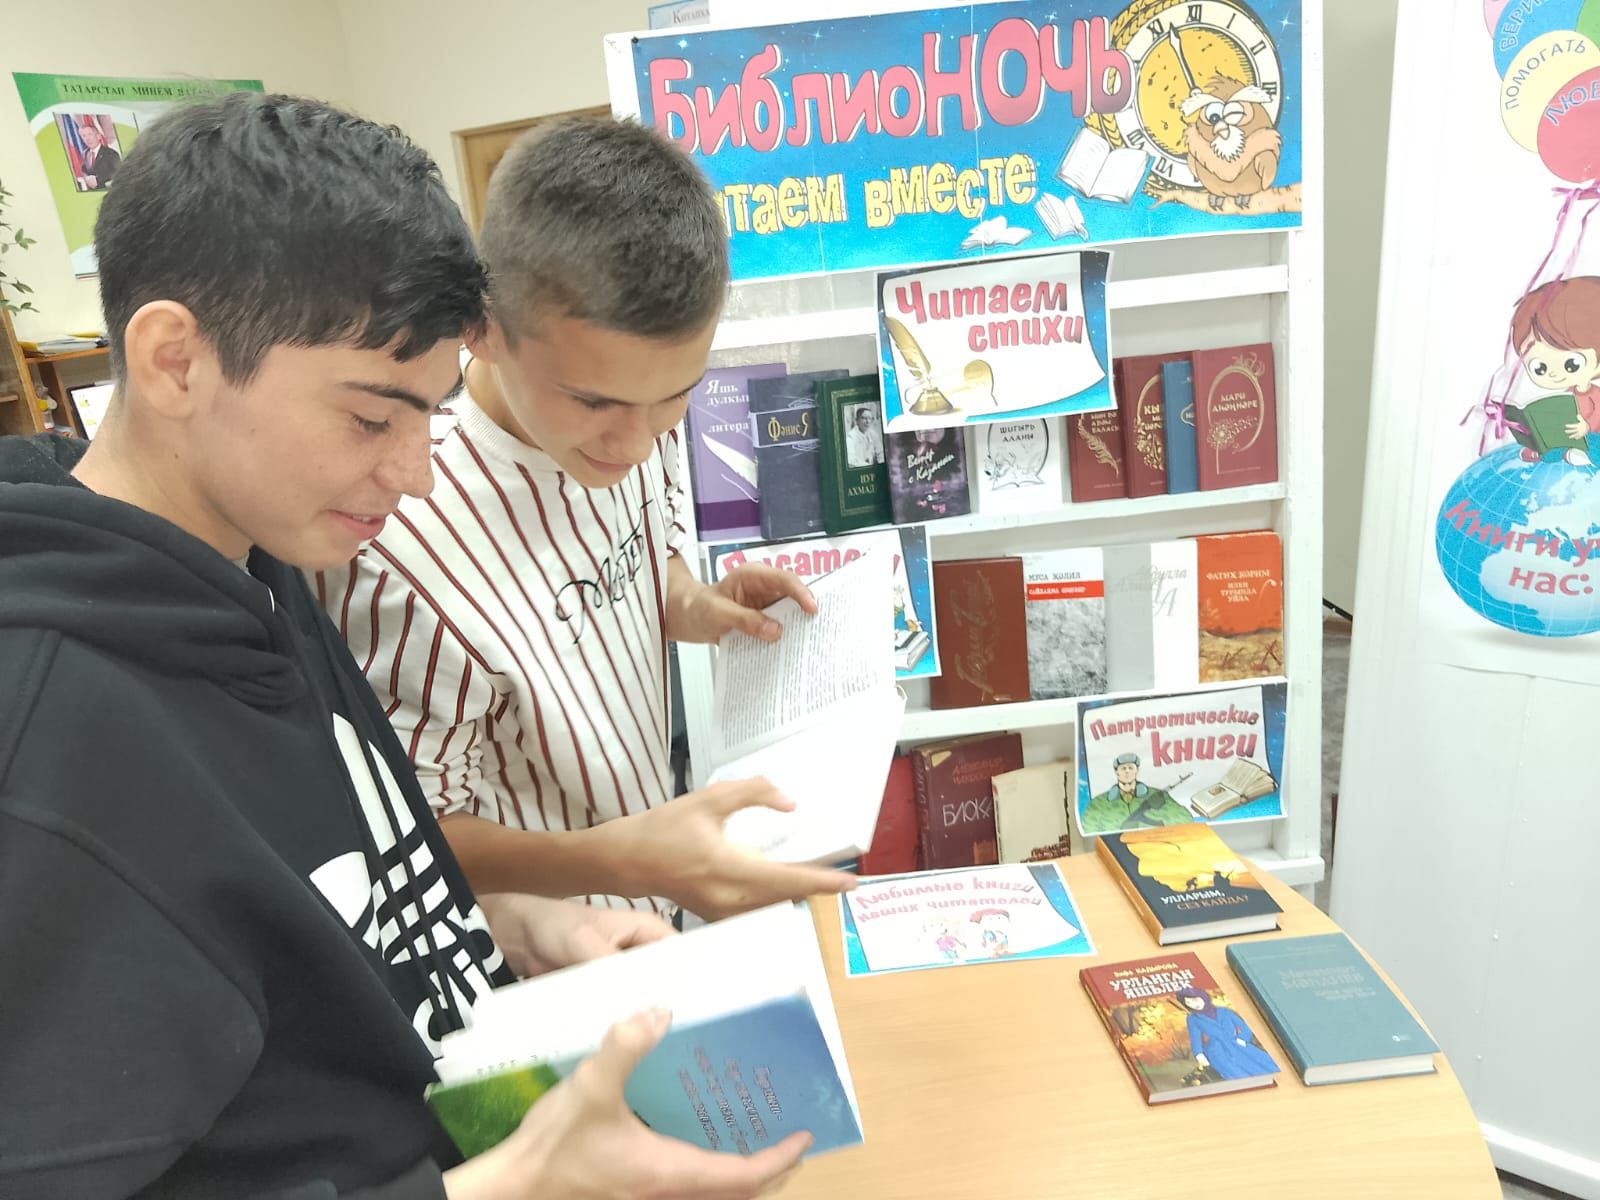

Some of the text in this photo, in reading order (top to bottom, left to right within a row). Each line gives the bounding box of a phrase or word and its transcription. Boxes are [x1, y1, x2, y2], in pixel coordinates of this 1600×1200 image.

[1505, 39, 1586, 110] ПОМОГАТЬ
[63, 83, 125, 97] ТАТАРСТАН
[713, 153, 1037, 238] таем вместе
[895, 281, 1067, 324] Читаем
[968, 315, 1084, 352] стихи
[705, 379, 738, 395] Яшь
[708, 421, 751, 435] литера
[1000, 424, 1035, 435] ШИГЫРЬ
[1002, 433, 1035, 443] АЛАНЫ
[1444, 499, 1560, 557] Книги
[1508, 567, 1594, 596] нас:
[1090, 704, 1259, 740] Патриотические
[1151, 731, 1258, 767] книги
[855, 877, 1035, 911] Любимые книги
[857, 895, 1042, 923] наших читателей
[1109, 968, 1195, 992] УРЛАНГАН
[1123, 980, 1194, 1000] ЯШЬЛЕК
